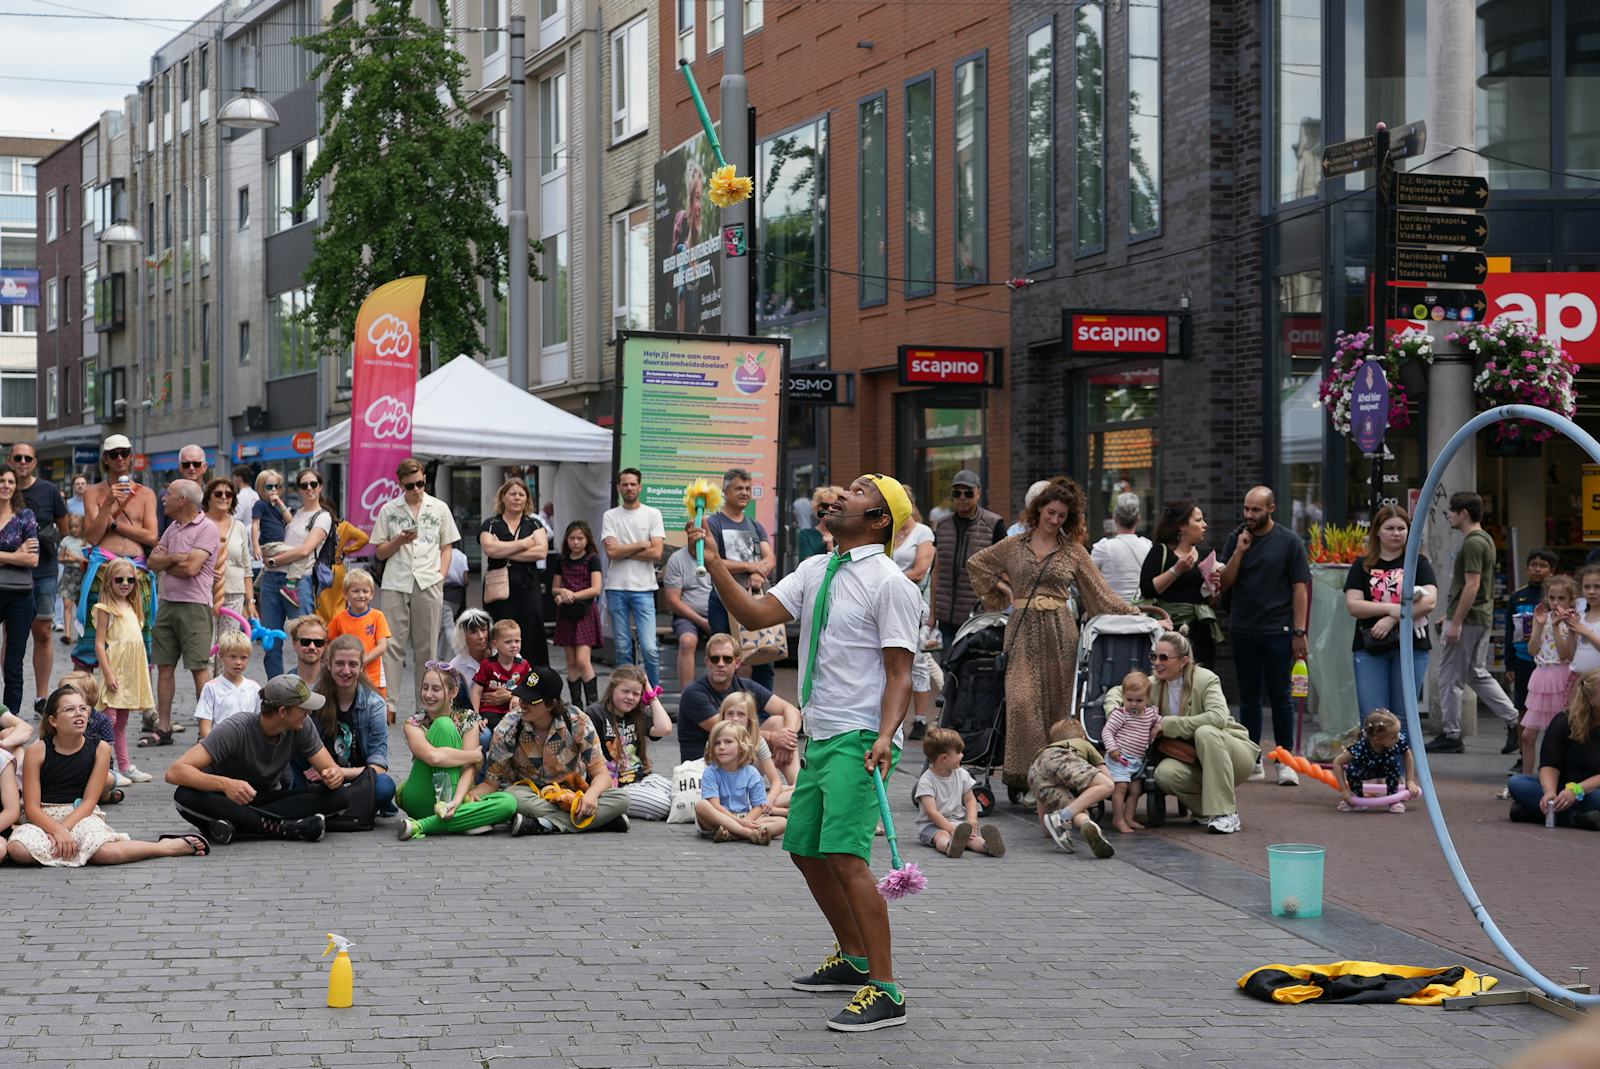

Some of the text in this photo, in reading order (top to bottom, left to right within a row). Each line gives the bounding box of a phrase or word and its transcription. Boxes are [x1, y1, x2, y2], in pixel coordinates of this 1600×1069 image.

[1399, 184, 1465, 195] Regionaal Archief
[1399, 193, 1442, 203] Bibliotheek
[1399, 223, 1415, 231] LUX
[1399, 269, 1443, 278] Stadswnkel
[1078, 325, 1161, 348] scapino
[643, 350, 660, 359] Help
[661, 351, 669, 359] jij
[643, 358, 729, 369] duurzaamheidsdoelen?
[911, 355, 979, 378] scapino
[788, 378, 833, 391] OSMO
[647, 486, 684, 496] Regionale
